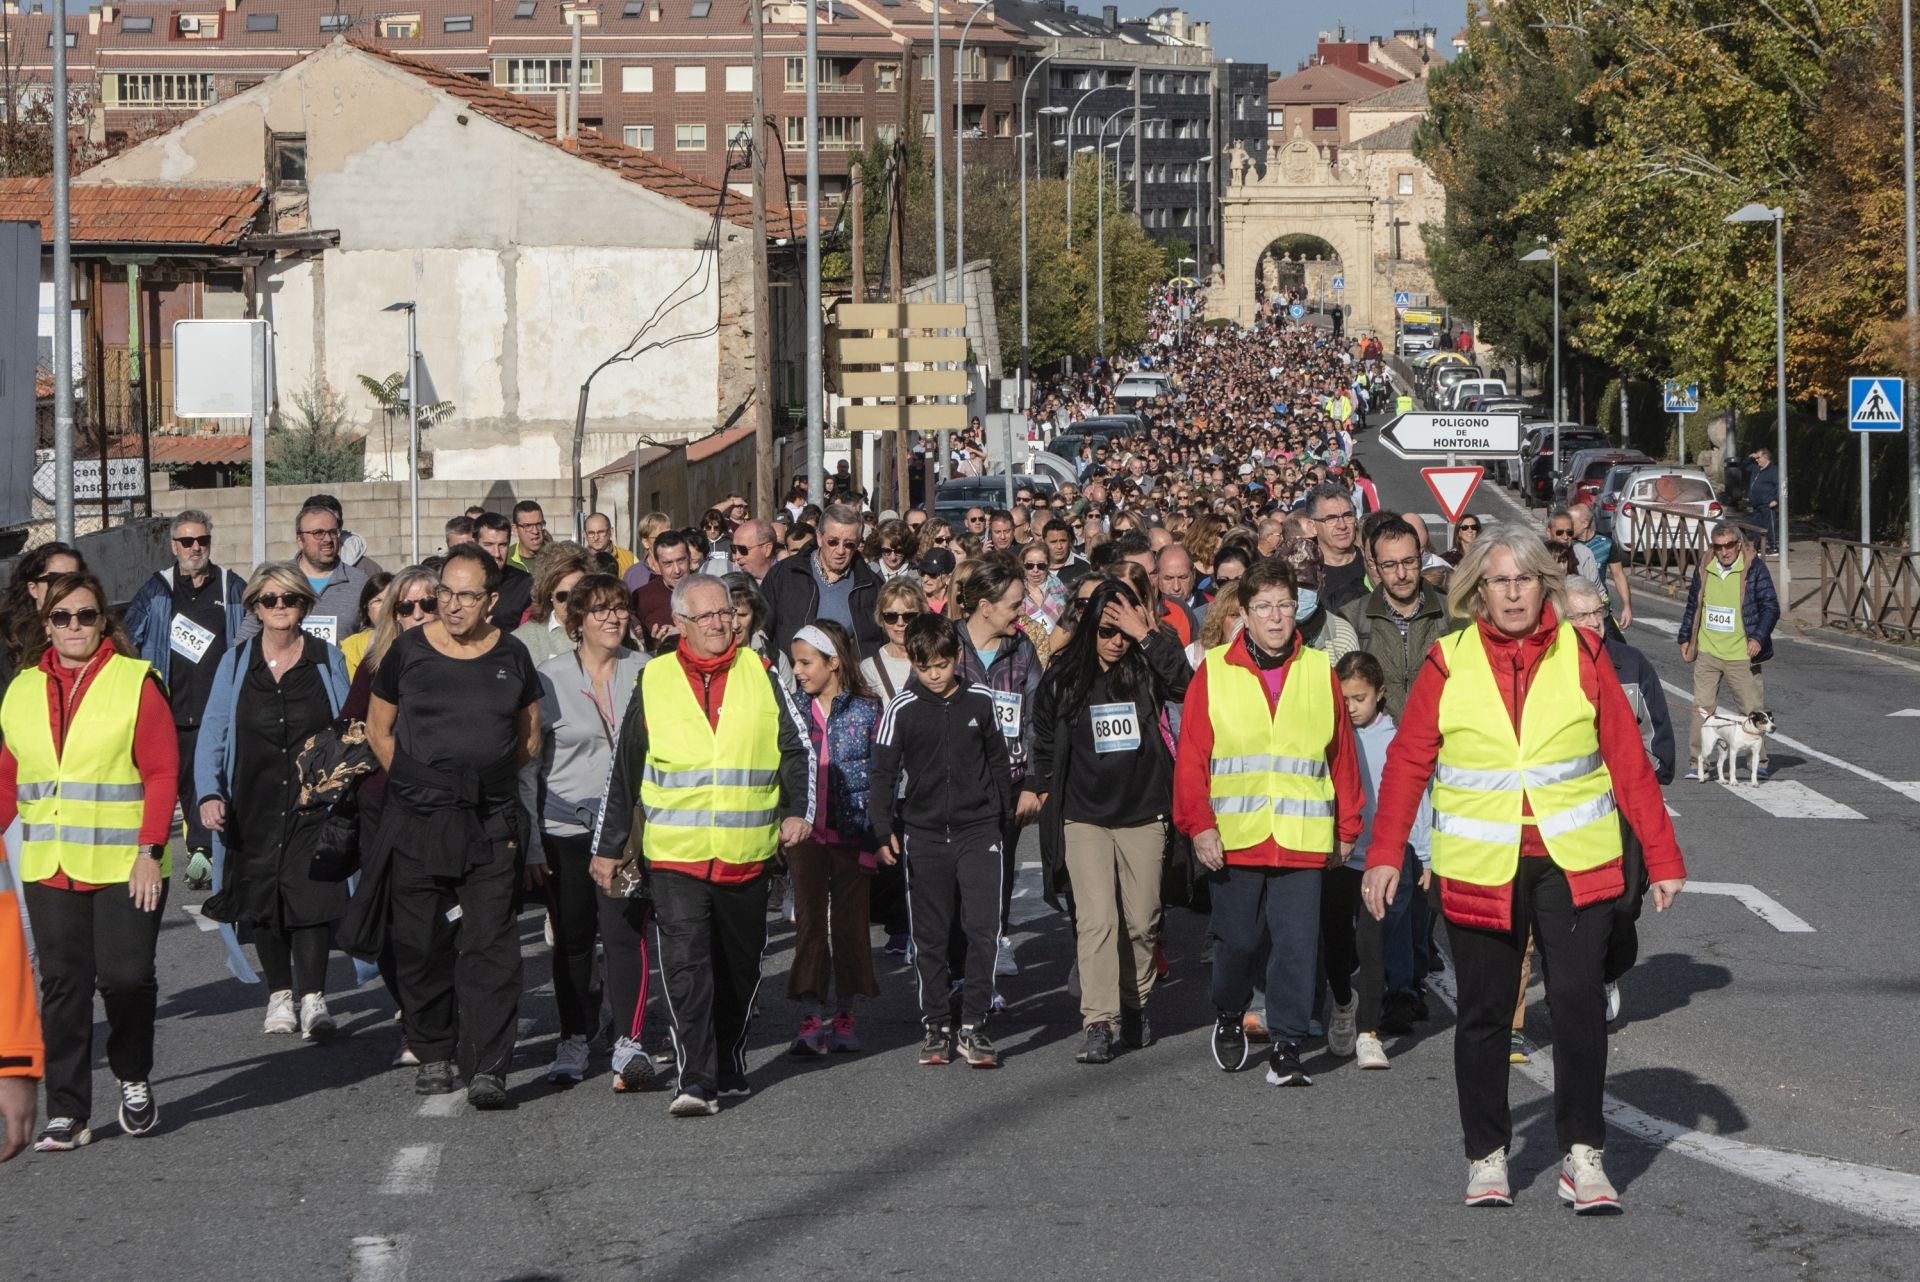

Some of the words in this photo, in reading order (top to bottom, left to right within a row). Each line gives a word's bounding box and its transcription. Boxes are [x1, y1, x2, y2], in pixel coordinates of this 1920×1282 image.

[1432, 418, 1489, 427] POLIGONO
[1433, 438, 1490, 448] HONTORIA
[122, 465, 136, 475] de
[1708, 613, 1731, 625] 6404
[1095, 718, 1132, 738] 6800
